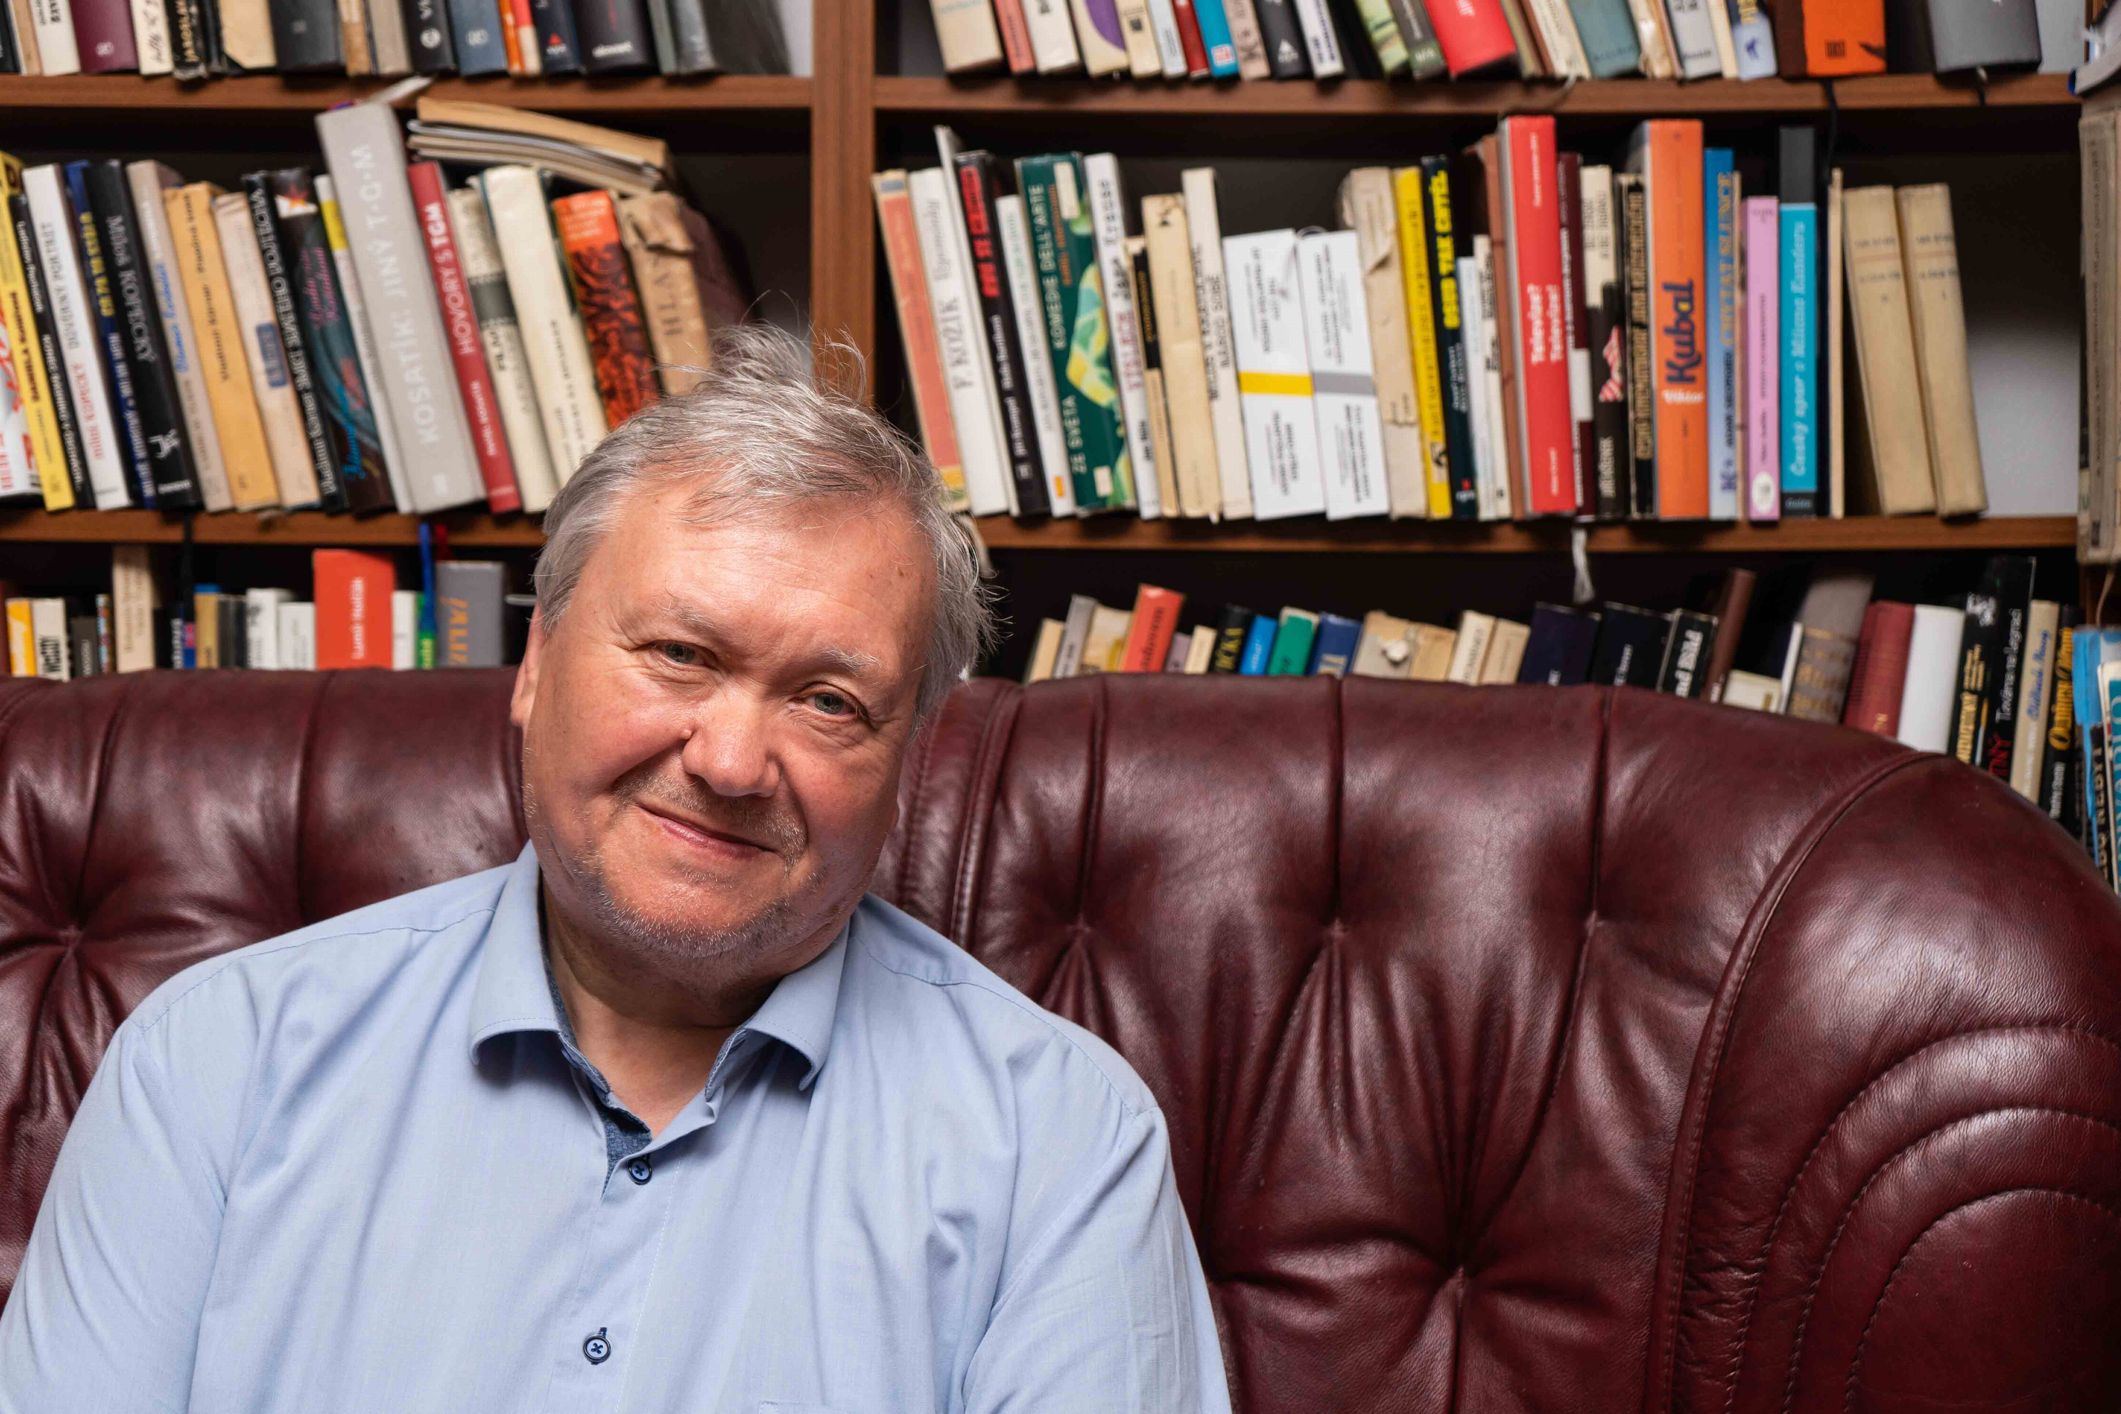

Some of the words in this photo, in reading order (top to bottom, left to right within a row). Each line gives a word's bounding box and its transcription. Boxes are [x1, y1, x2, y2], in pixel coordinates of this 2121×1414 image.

[421, 201, 449, 248] TGM
[434, 248, 454, 263] S
[1027, 183, 1056, 271] DELL'ARTE
[364, 236, 407, 303] JINÝ
[1790, 221, 1805, 292] Kunderu
[113, 268, 158, 365] KOPECKÝ
[437, 264, 477, 354] HOVORY
[1041, 274, 1067, 349] KOMEDIE
[1524, 282, 1549, 363] Televize?
[1662, 279, 1703, 385] Kubal
[1790, 298, 1805, 356] Milana
[1060, 394, 1083, 448] SVĚTA
[1662, 388, 1703, 404] Viktor
[1792, 376, 1806, 416] spor
[1069, 453, 1087, 474] ZE
[1788, 421, 1806, 475] Český
